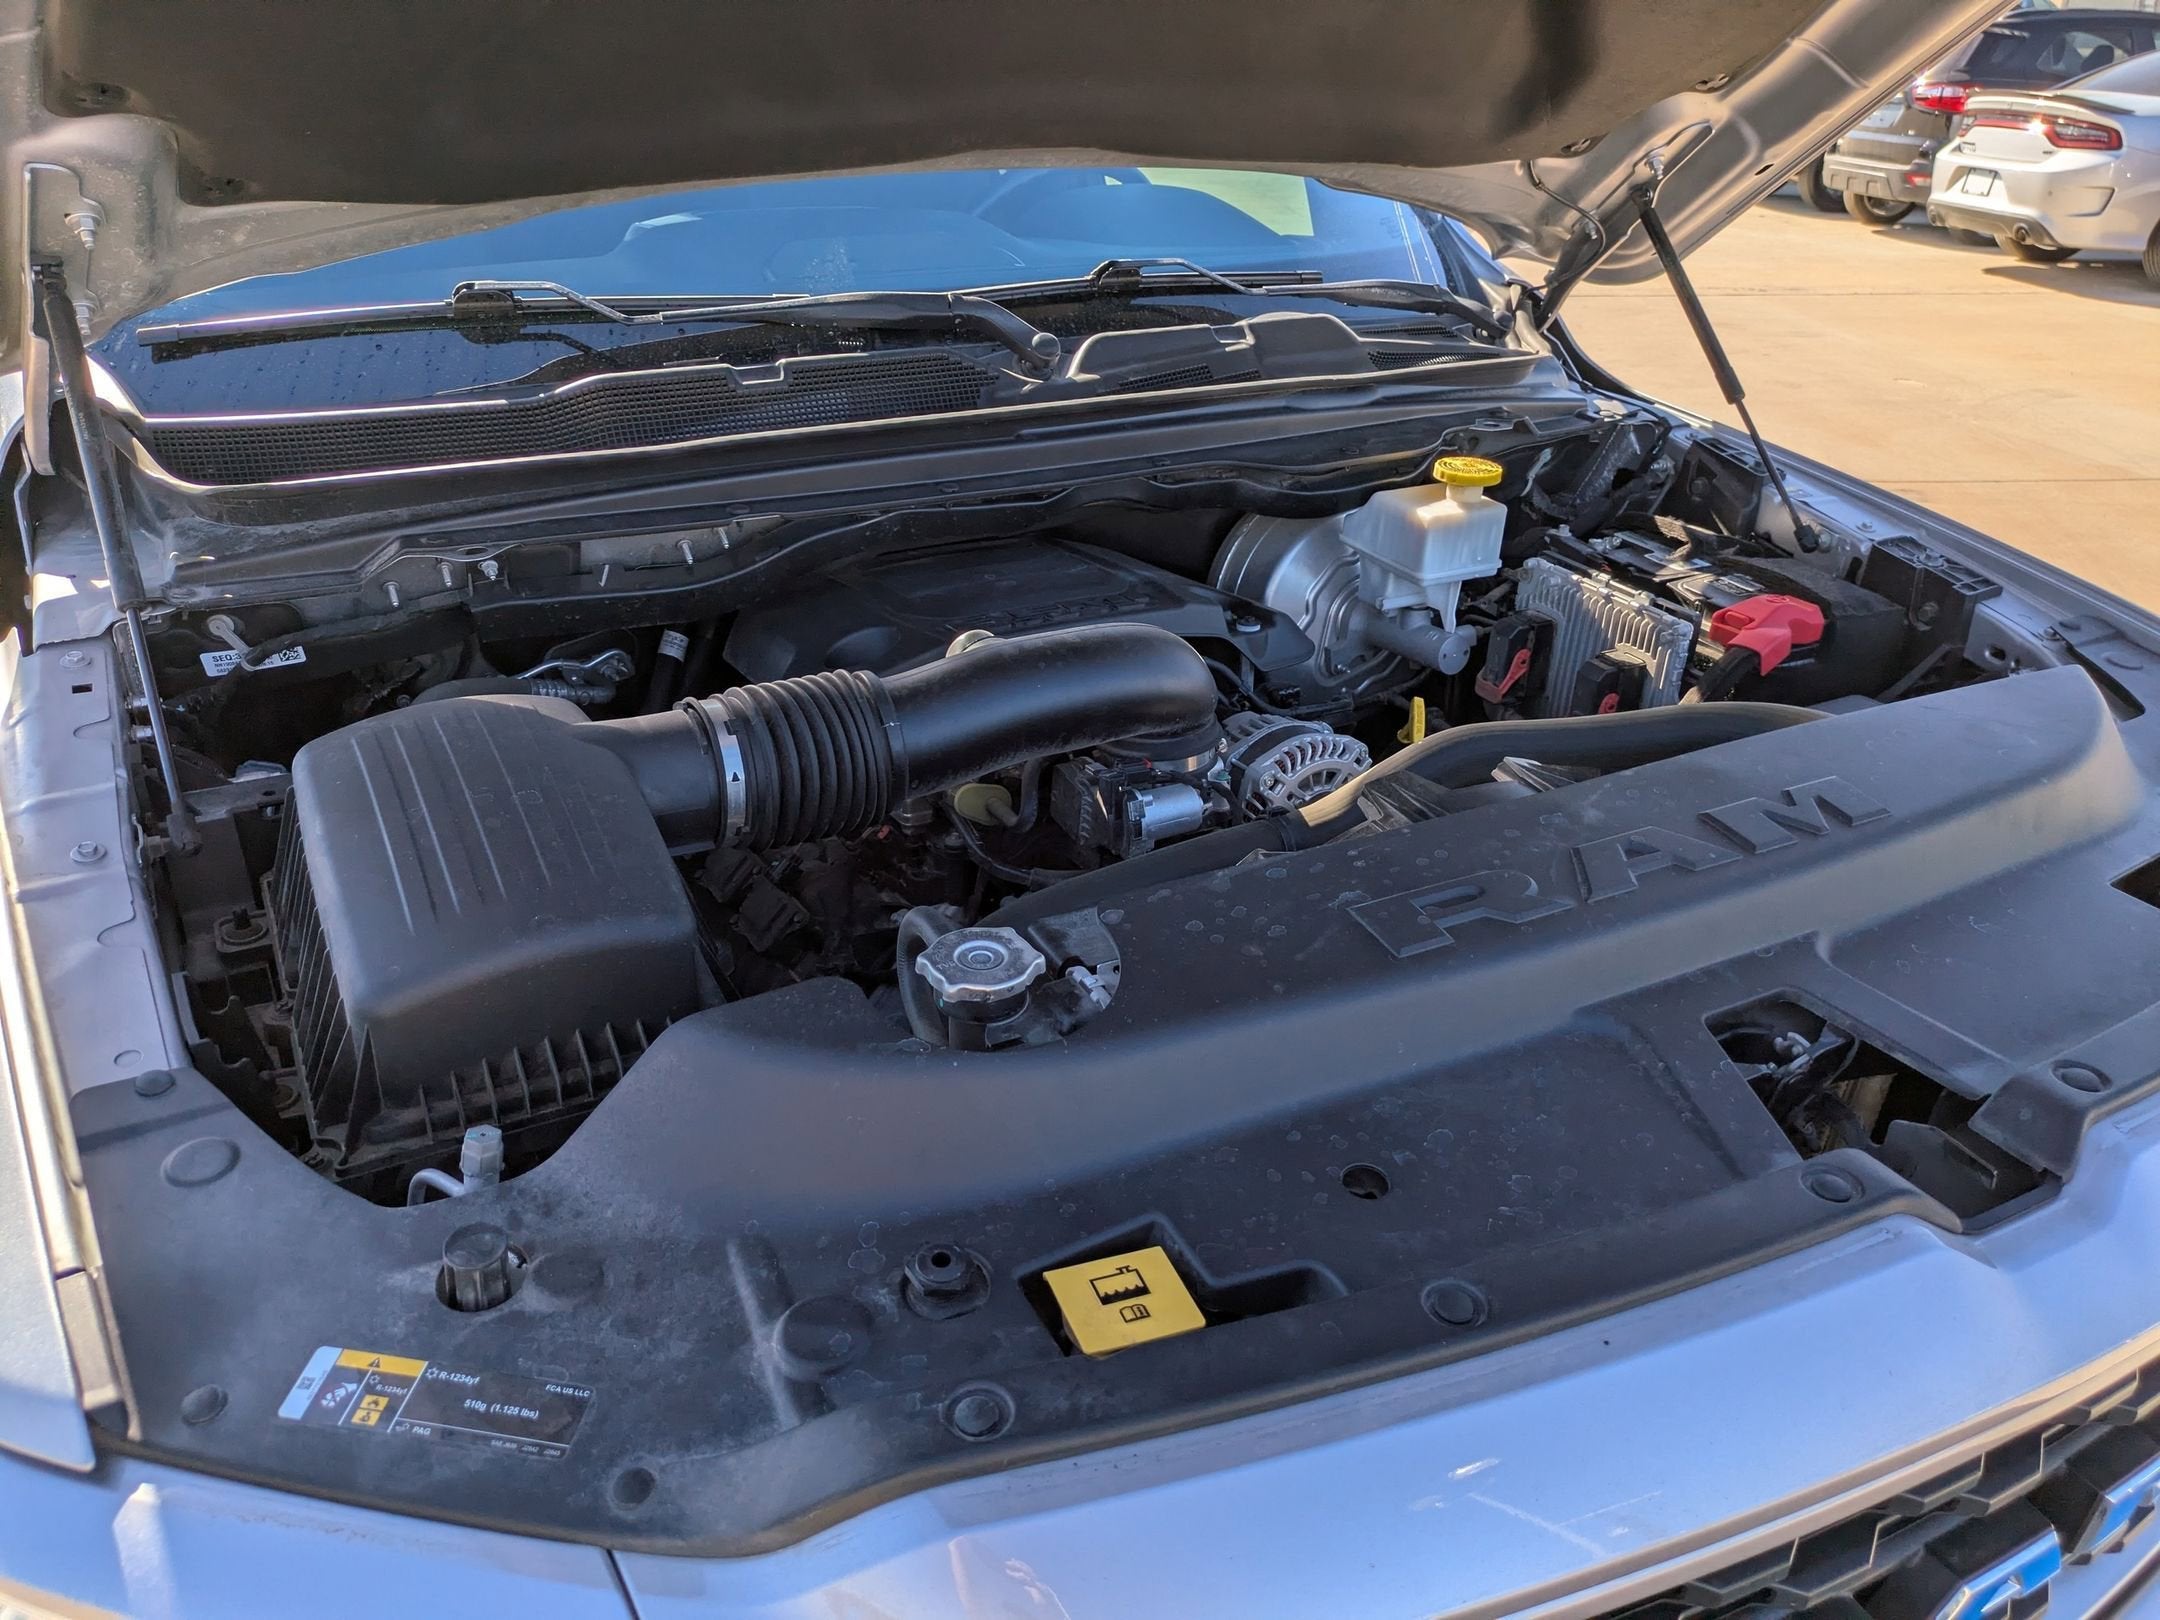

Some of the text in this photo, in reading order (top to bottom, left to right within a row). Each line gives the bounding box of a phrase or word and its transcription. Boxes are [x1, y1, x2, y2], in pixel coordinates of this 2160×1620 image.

[1346, 774, 1892, 958] RAM
[438, 1371, 481, 1386] R-1234yf
[545, 1384, 561, 1393] FCA
[574, 1388, 590, 1397] LLC
[464, 1398, 539, 1419] 510g (1.125 lbs)
[412, 1425, 431, 1436] PAG
